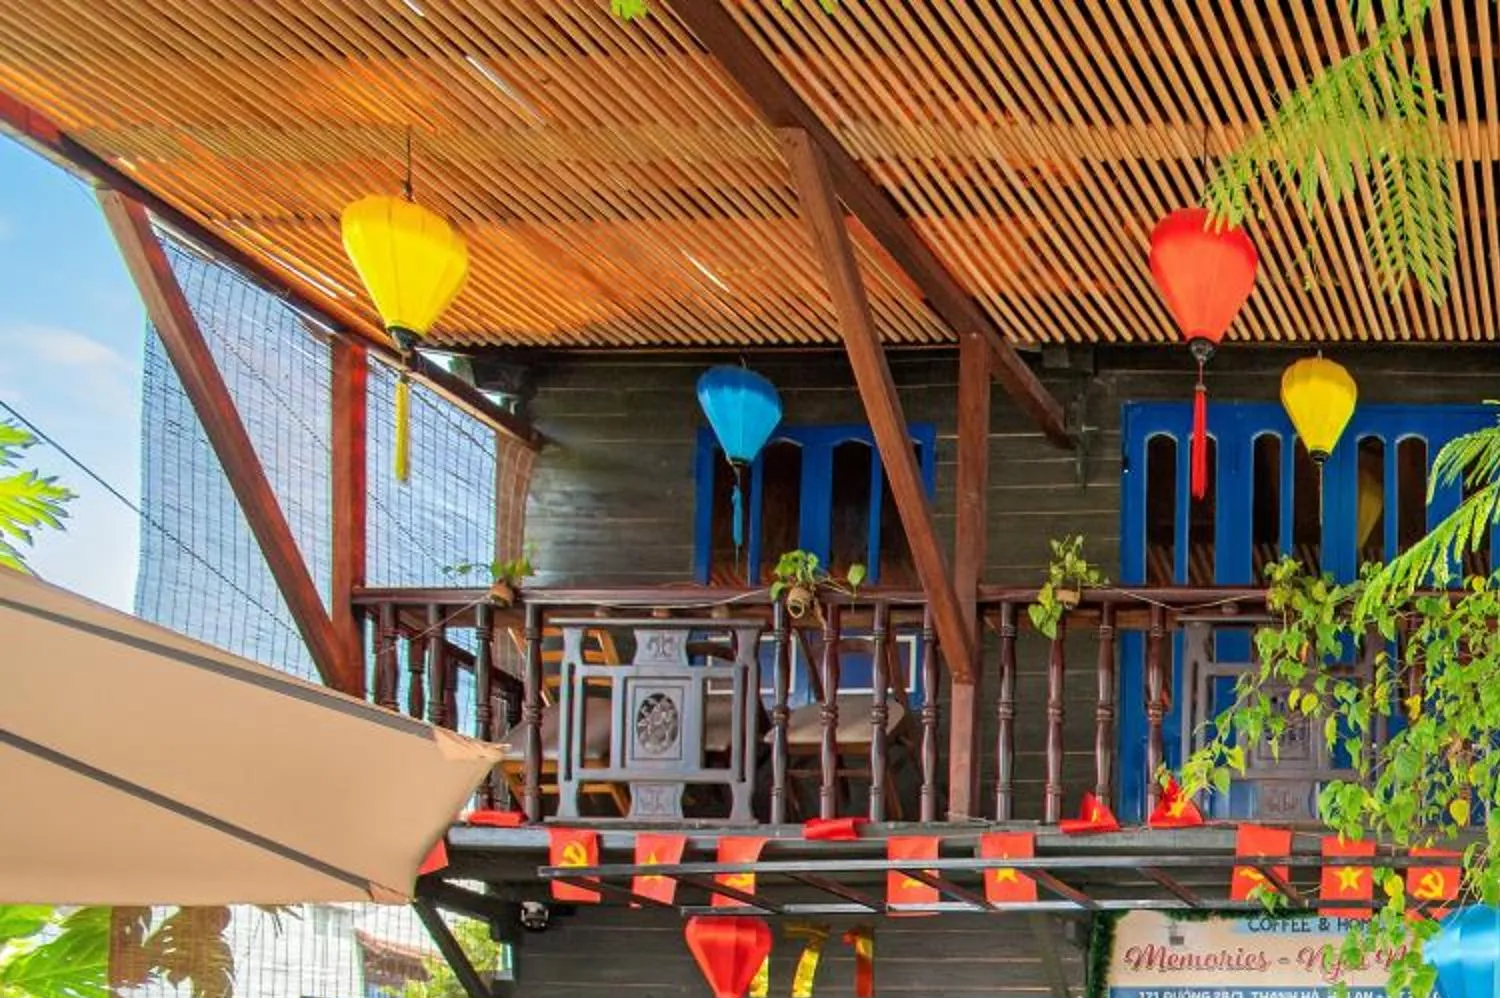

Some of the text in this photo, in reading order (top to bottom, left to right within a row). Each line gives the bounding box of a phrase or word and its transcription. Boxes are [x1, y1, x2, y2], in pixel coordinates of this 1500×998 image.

[1247, 917, 1311, 932] COFFEE
[1318, 917, 1331, 932] &
[1123, 943, 1272, 973] Memories
